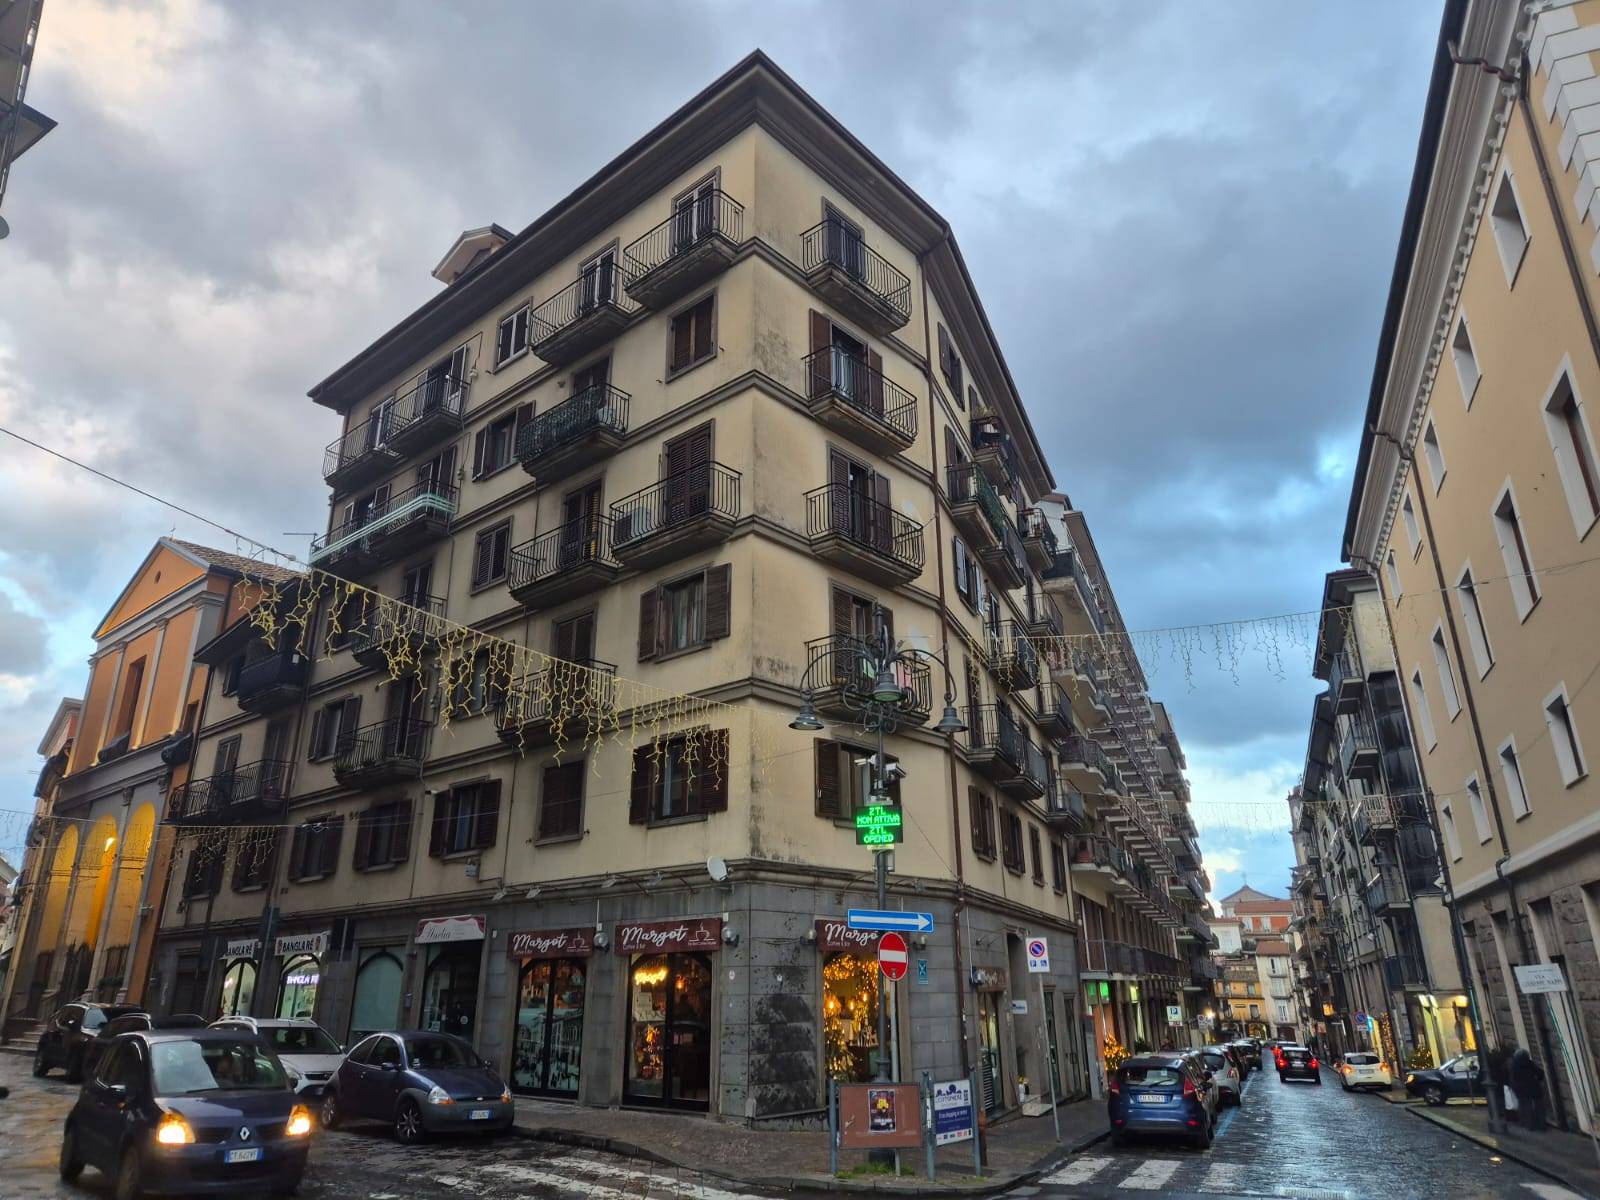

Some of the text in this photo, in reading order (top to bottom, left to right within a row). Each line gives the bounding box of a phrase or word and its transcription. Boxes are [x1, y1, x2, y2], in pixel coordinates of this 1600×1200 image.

[869, 806, 886, 816] ZTL
[857, 814, 901, 825] NON ATTIVA
[870, 826, 887, 835] ZTL
[863, 833, 894, 843] OPENED
[622, 925, 689, 947] Margot
[825, 923, 878, 946] Margo
[512, 933, 569, 953] Margot
